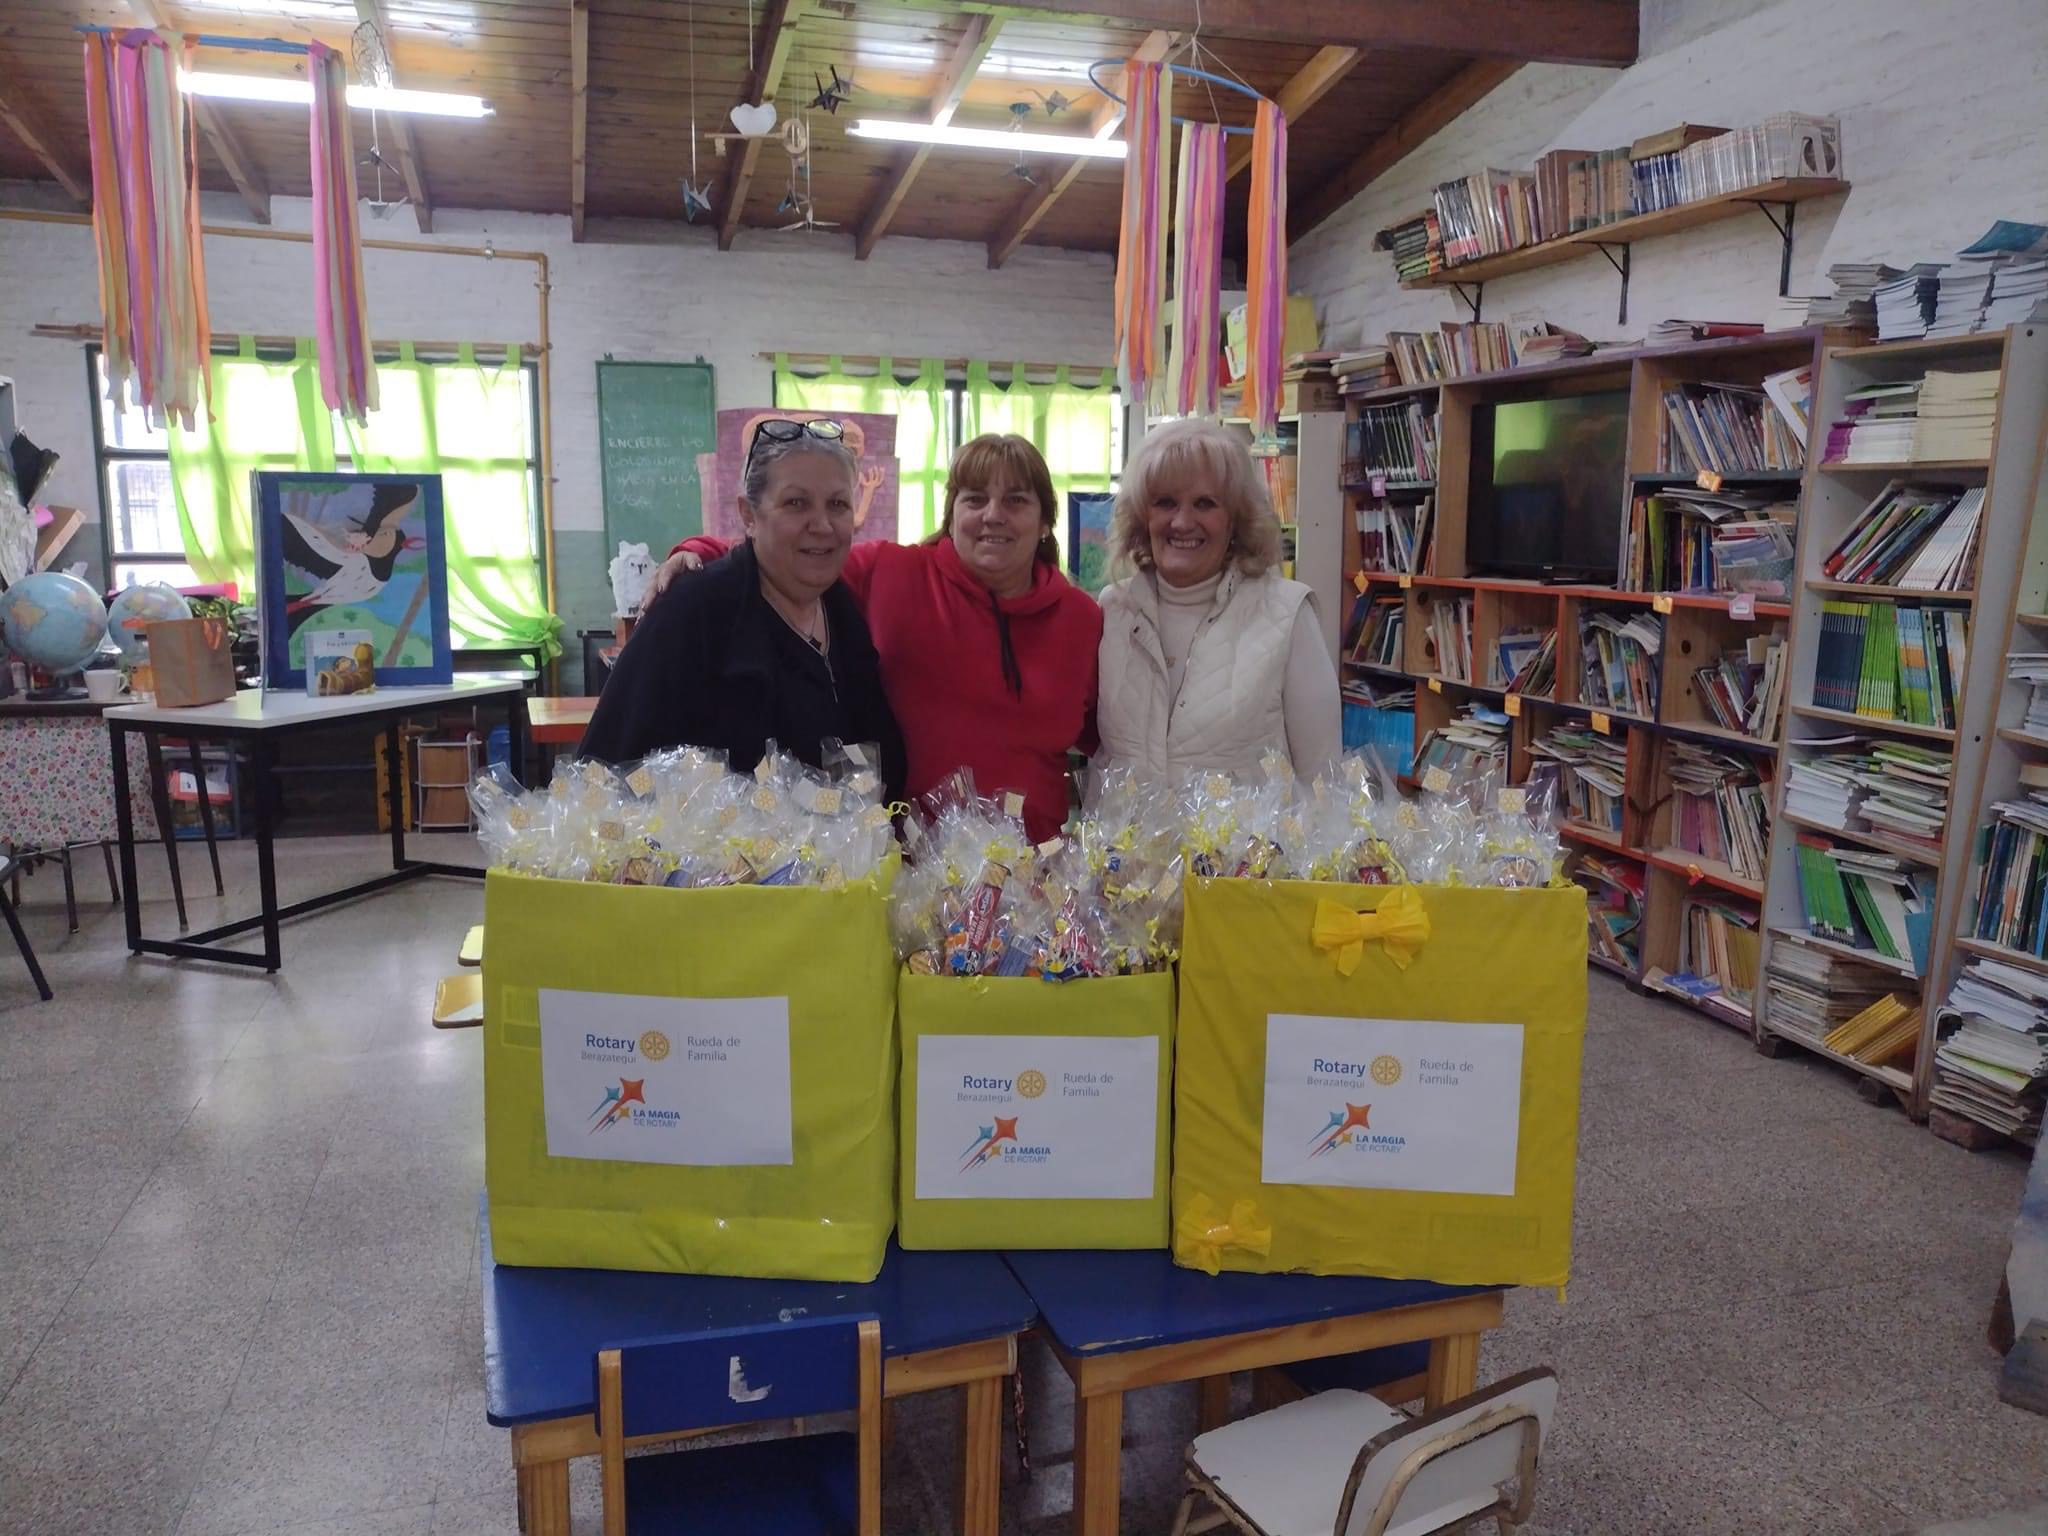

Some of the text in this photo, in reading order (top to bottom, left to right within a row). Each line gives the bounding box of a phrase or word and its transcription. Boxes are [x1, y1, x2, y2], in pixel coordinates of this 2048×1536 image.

[586, 1034, 635, 1052] Rotary
[688, 1036, 741, 1048] Rueda de
[581, 1052, 637, 1064] Berazategui
[688, 1050, 727, 1061] Familia
[1314, 1058, 1366, 1077] Rotary
[1420, 1059, 1474, 1072] Rueda de
[963, 1075, 1013, 1092] Rotary
[1063, 1073, 1114, 1084] Rueda de
[1307, 1075, 1365, 1089] Berazategui
[1419, 1073, 1459, 1086] Familia
[1063, 1086, 1100, 1097] Familia
[957, 1092, 1012, 1103] Berazategui
[633, 1109, 681, 1120] LA MAGIA
[633, 1118, 677, 1128] DE ROTARY
[1356, 1135, 1406, 1145] LA MAGIA
[1005, 1146, 1051, 1155] LA MAGIA
[1355, 1144, 1402, 1153] DE ROTARY
[1004, 1155, 1047, 1163] DE ROTARY
